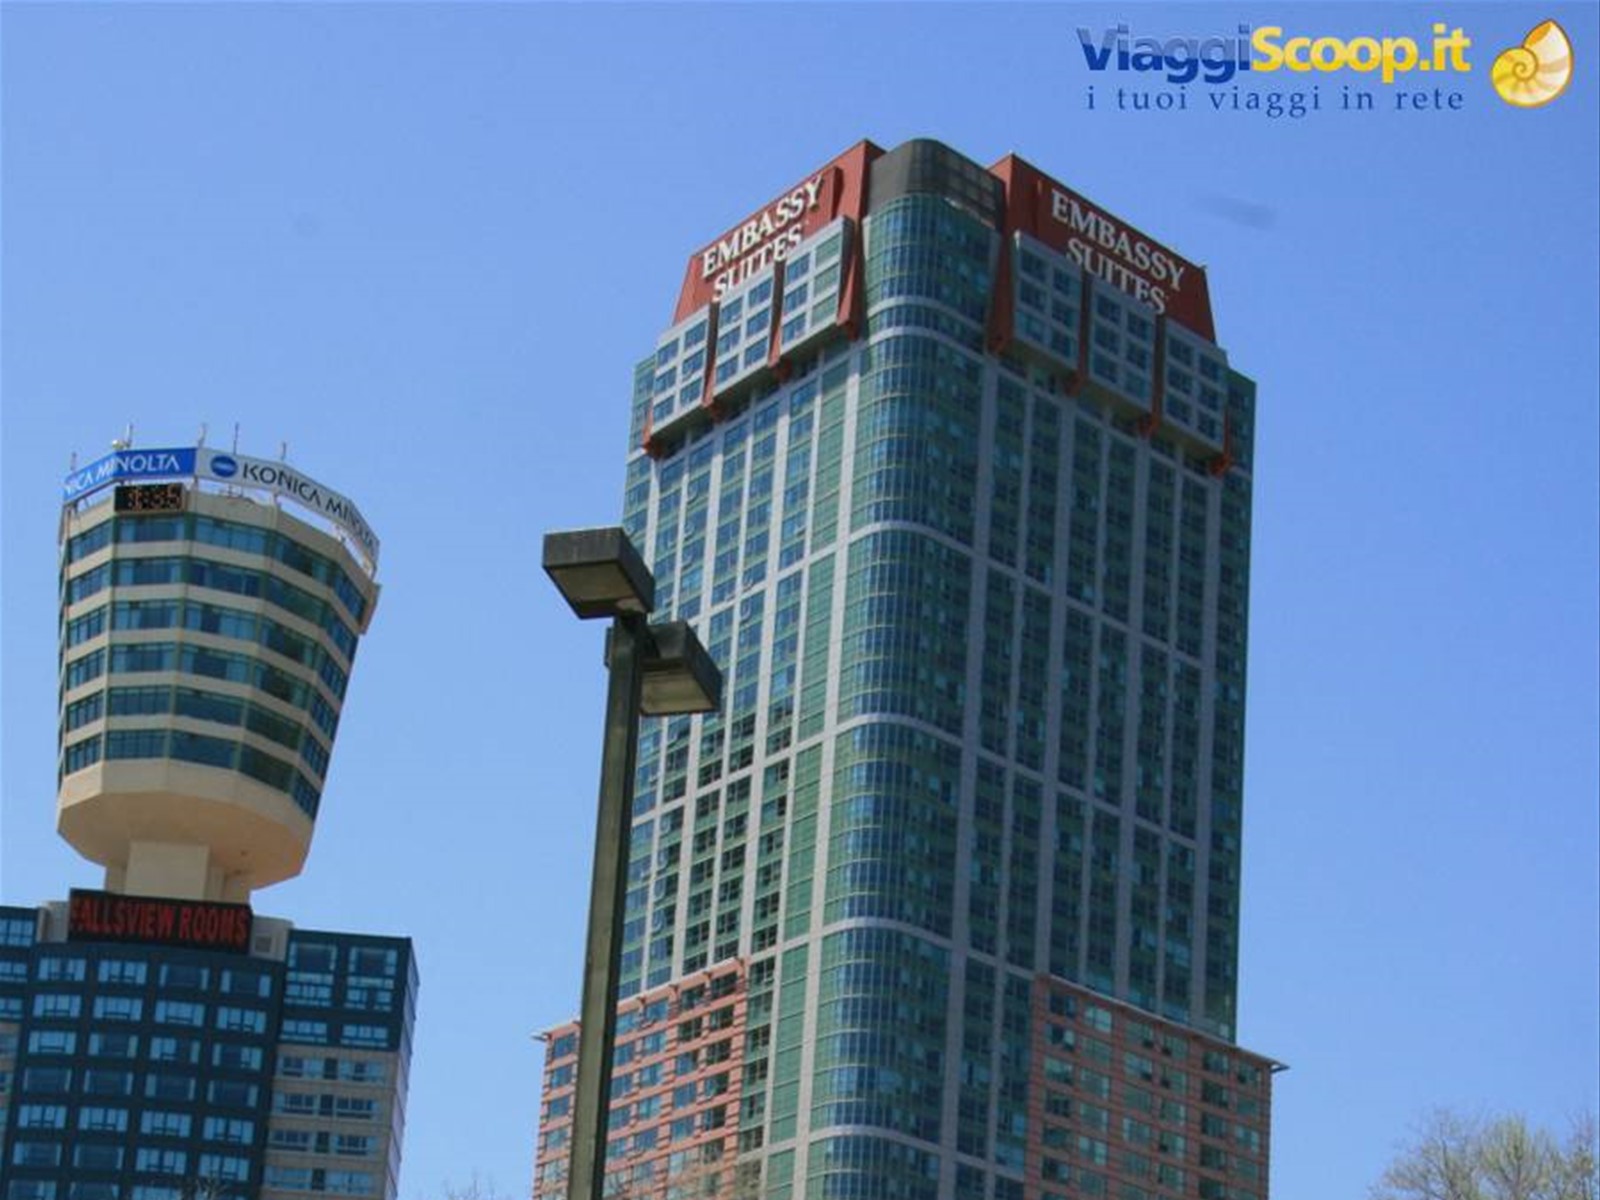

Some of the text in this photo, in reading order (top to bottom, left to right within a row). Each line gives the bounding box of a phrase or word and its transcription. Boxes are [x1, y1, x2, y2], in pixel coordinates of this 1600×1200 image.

[703, 173, 824, 279] EMBASSY
[712, 224, 802, 302] SUITES
[1052, 188, 1185, 291] EMBASSY
[1066, 237, 1166, 315] SUITES
[96, 453, 181, 481] MINOLTA
[242, 463, 321, 507] KONICA
[178, 905, 249, 945] ROOMS
